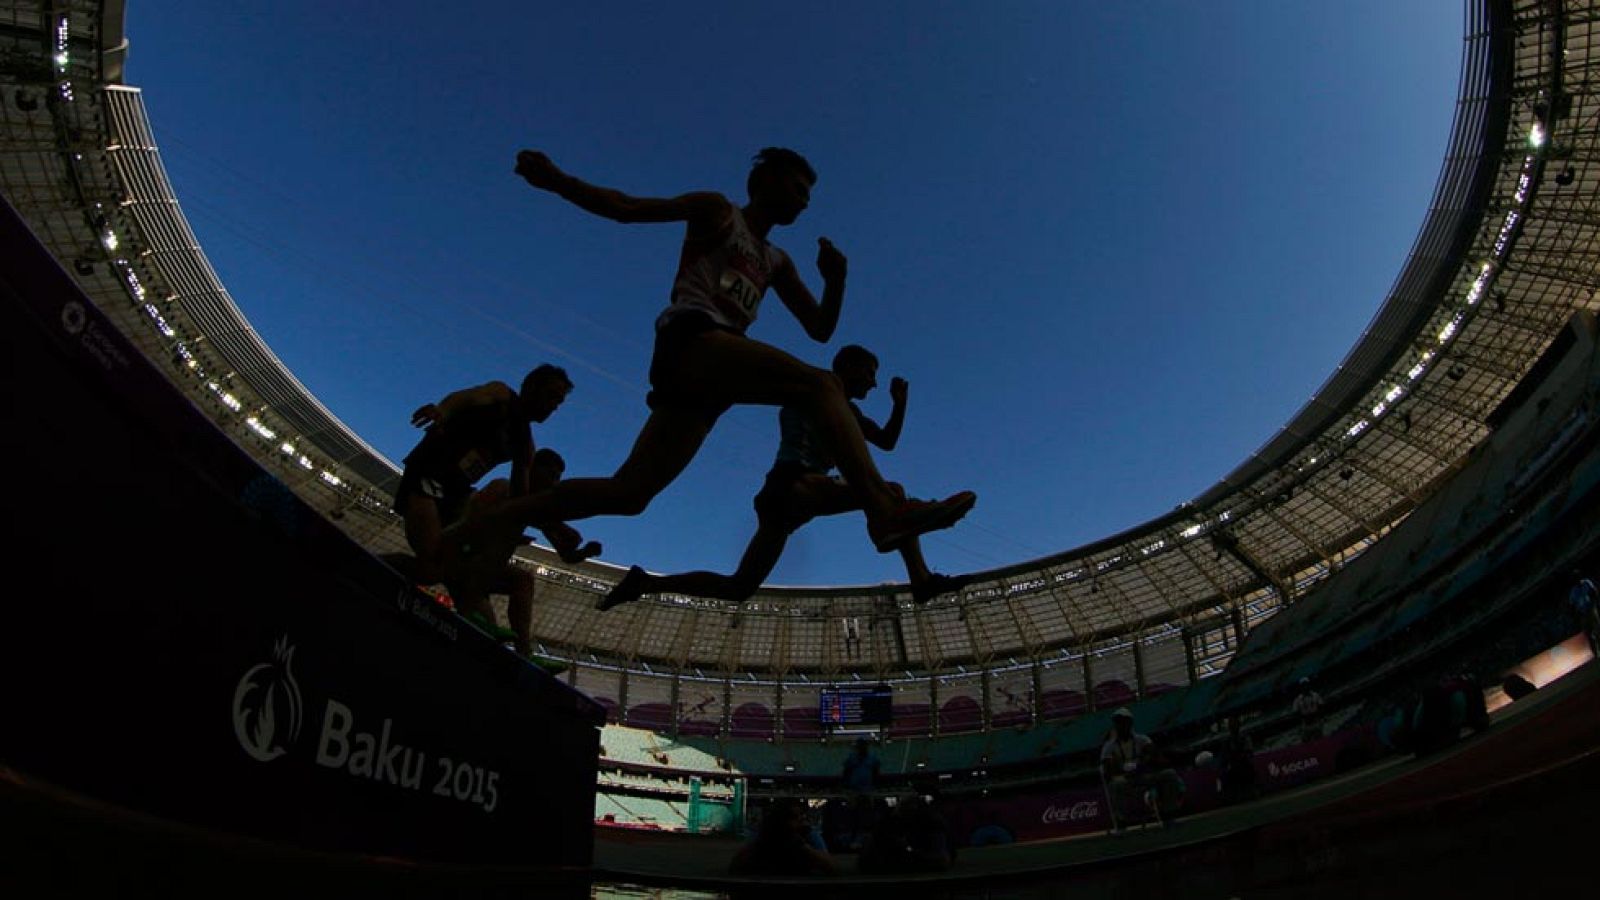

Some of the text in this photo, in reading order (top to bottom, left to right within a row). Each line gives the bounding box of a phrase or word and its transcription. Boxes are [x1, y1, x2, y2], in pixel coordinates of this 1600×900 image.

[315, 698, 501, 814] Baku 2015
[1281, 757, 1320, 775] SOCAR
[1042, 801, 1099, 824] Coca-Cola
